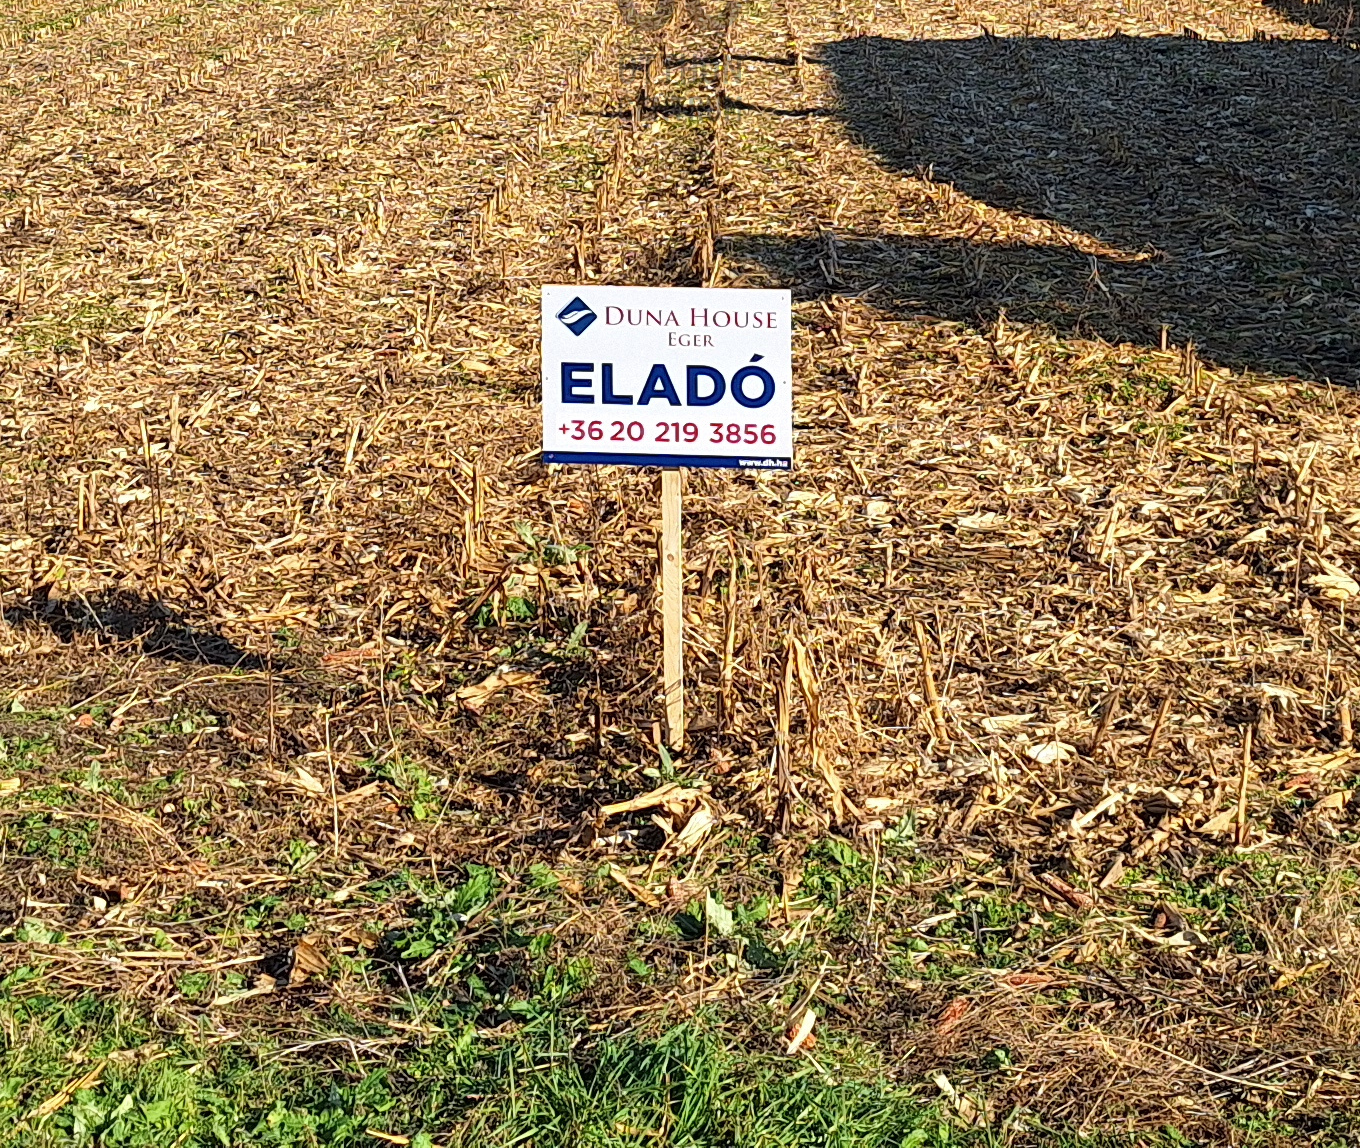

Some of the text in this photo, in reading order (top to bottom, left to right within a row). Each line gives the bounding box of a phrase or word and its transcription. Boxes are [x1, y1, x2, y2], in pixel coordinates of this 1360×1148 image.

[605, 306, 778, 329] DUNA HOUSE
[668, 331, 715, 347] EGER
[560, 353, 776, 409] ELADÓ
[558, 419, 777, 445] +36 20 219 3856
